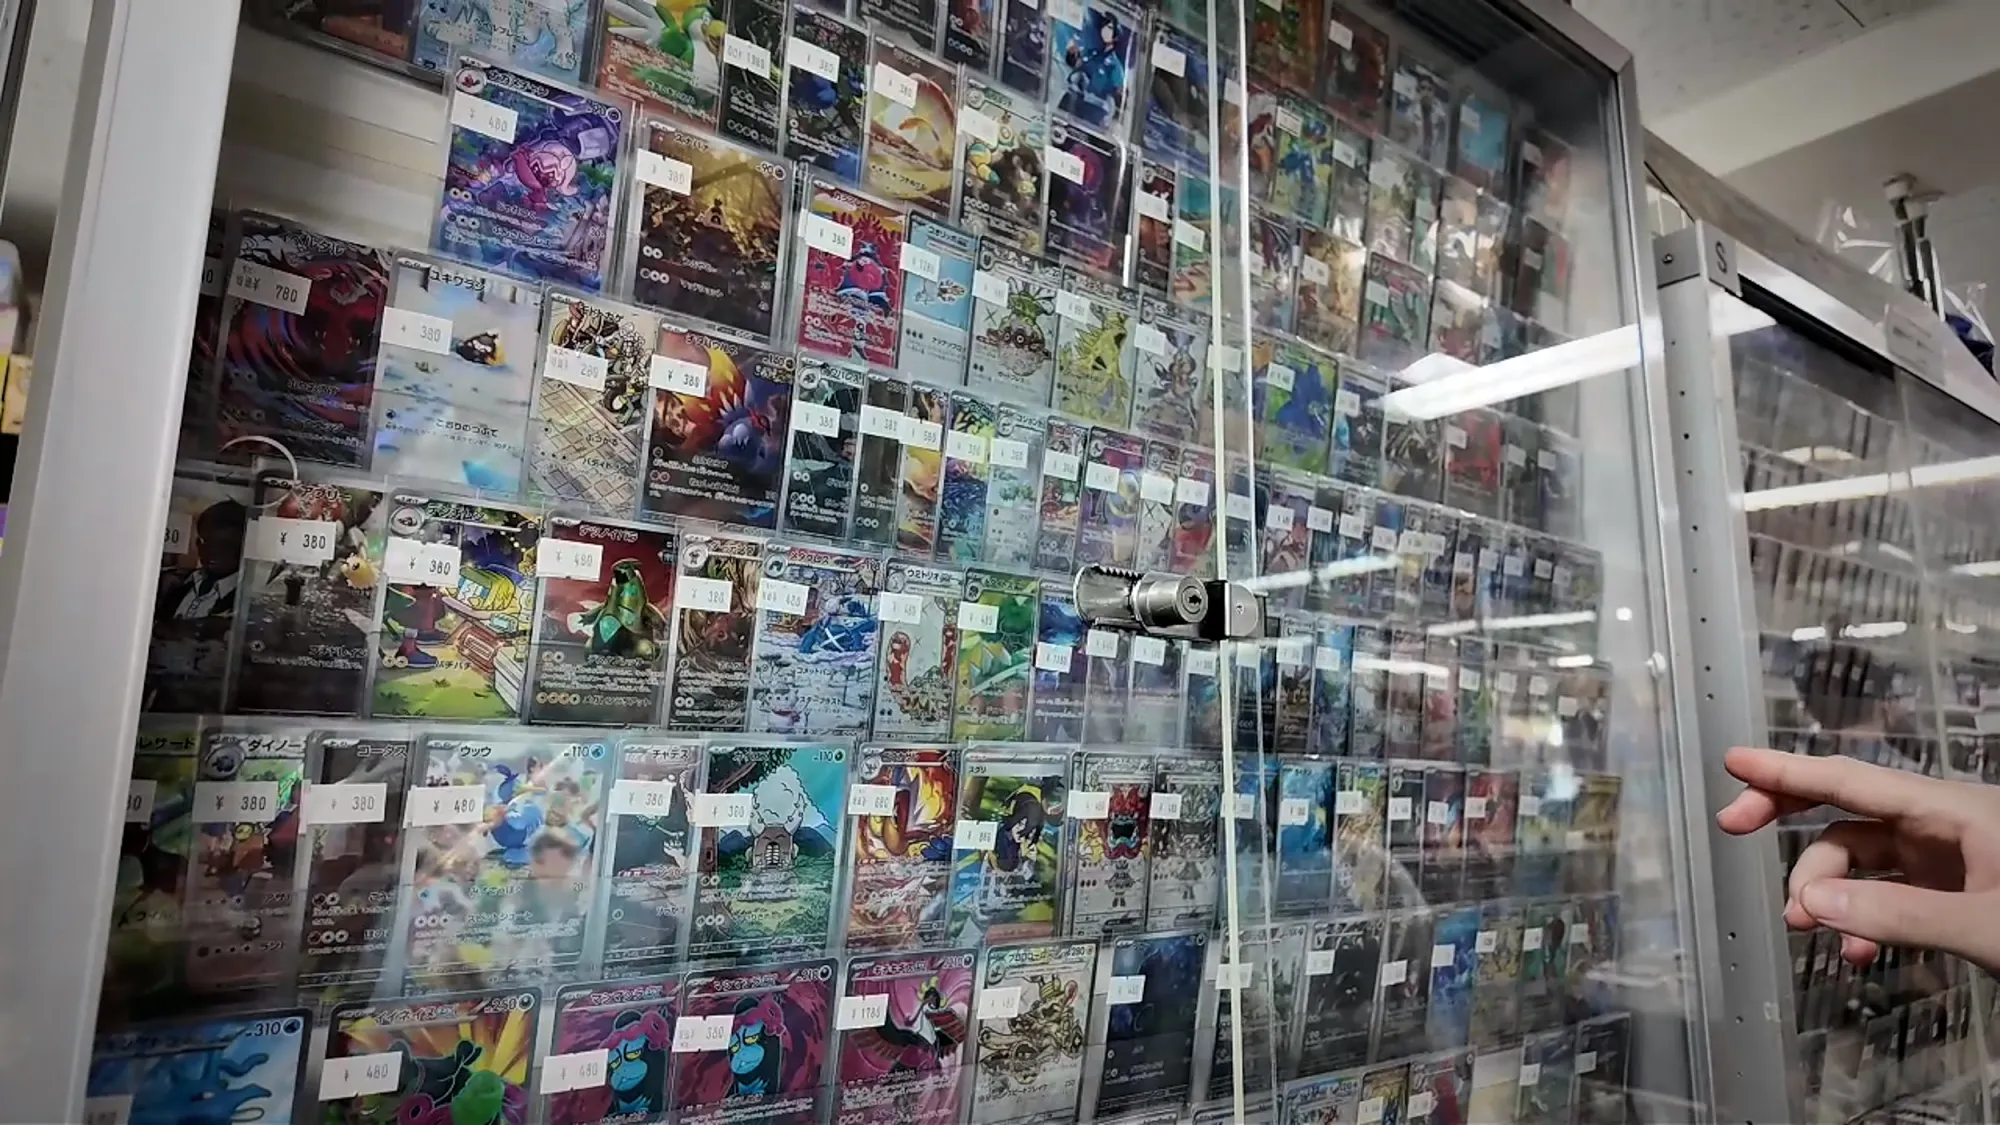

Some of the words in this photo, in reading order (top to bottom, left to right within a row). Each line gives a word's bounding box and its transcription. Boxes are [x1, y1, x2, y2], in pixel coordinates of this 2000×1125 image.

[1715, 240, 1728, 275] S
[429, 267, 485, 292] ユキワラシ
[275, 284, 298, 303] 780
[420, 326, 441, 342] 380
[435, 417, 500, 438] こおりのつぶて
[280, 532, 288, 546] ¥
[303, 533, 326, 549] 380
[429, 560, 451, 576] 380
[357, 744, 409, 758] コータス
[460, 745, 492, 758] ウッウ
[571, 746, 590, 758] 110
[652, 748, 689, 759] チャデス
[215, 796, 224, 811] ¥
[240, 796, 267, 811] 380
[352, 796, 375, 811] 380
[453, 799, 476, 814] 480
[254, 1022, 281, 1036] 310
[366, 1064, 389, 1079] 480
[579, 1063, 598, 1077] 480
